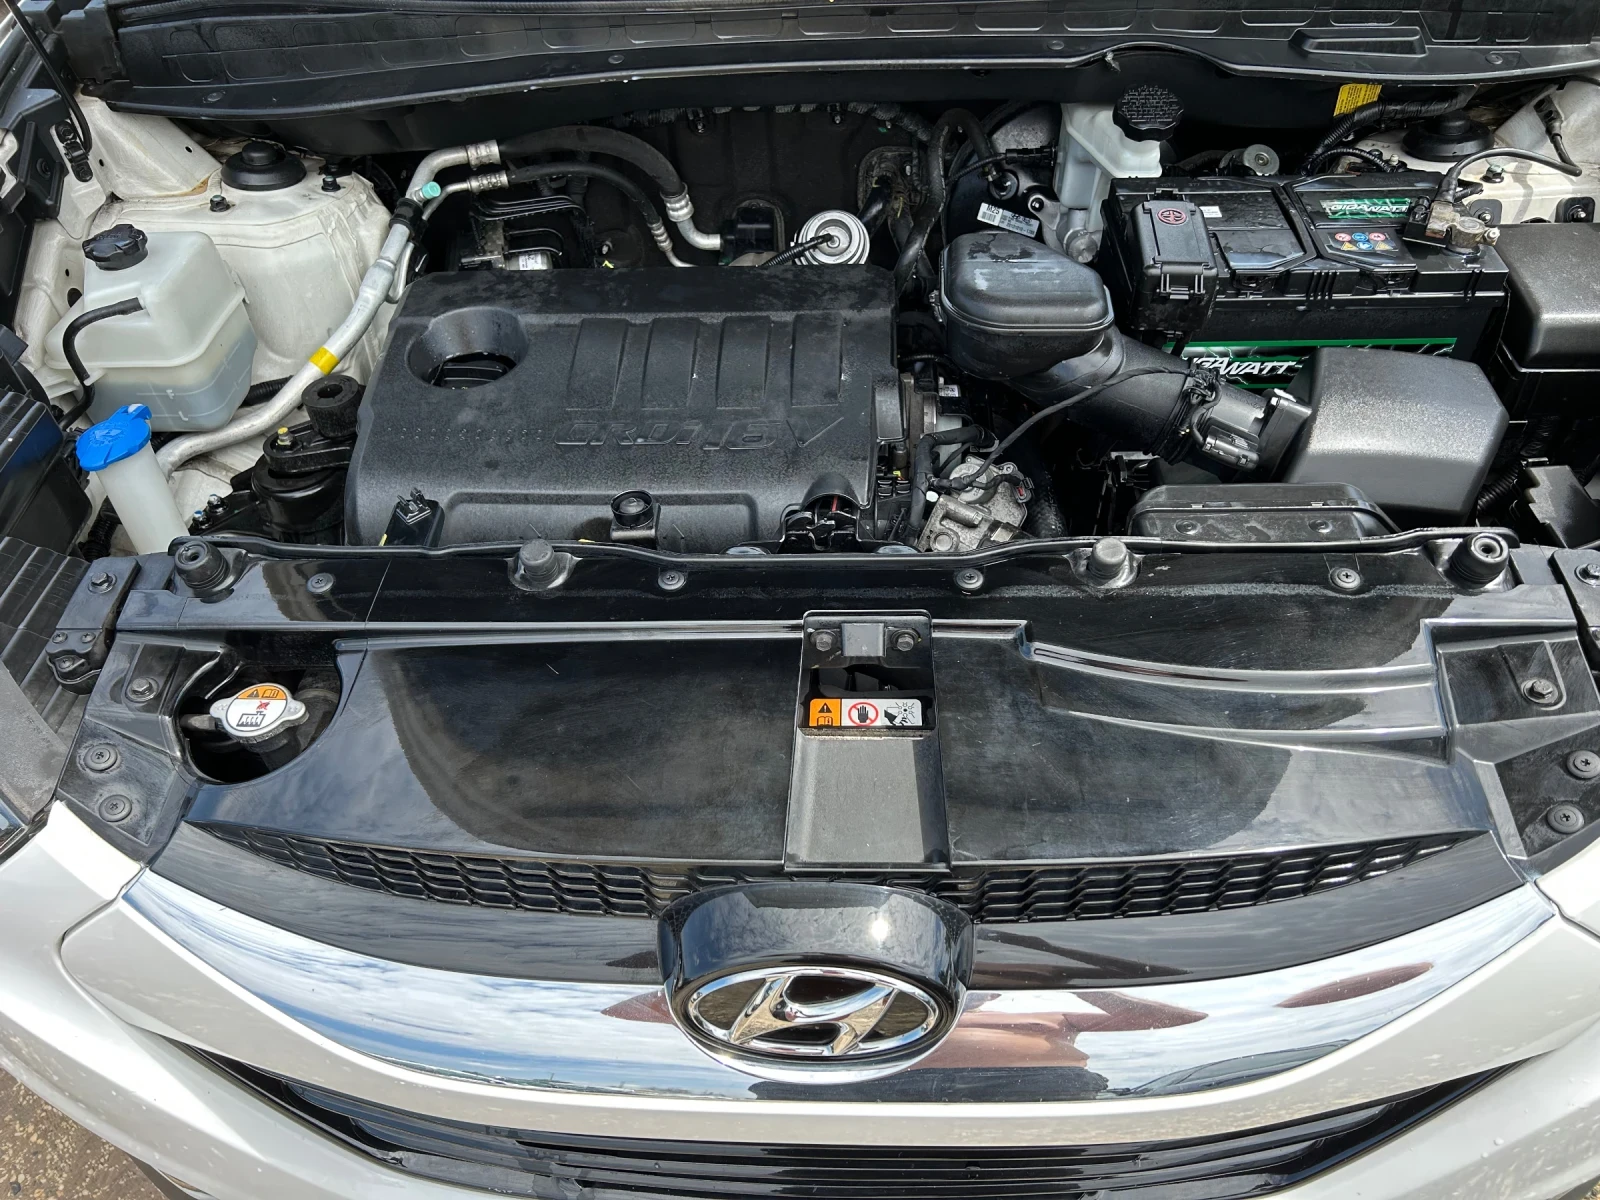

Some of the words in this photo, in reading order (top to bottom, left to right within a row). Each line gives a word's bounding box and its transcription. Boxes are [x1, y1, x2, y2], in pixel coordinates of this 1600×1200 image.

[986, 204, 1000, 215] M25
[1330, 203, 1409, 213] GIGAWATT
[1193, 357, 1297, 375] GAWATT
